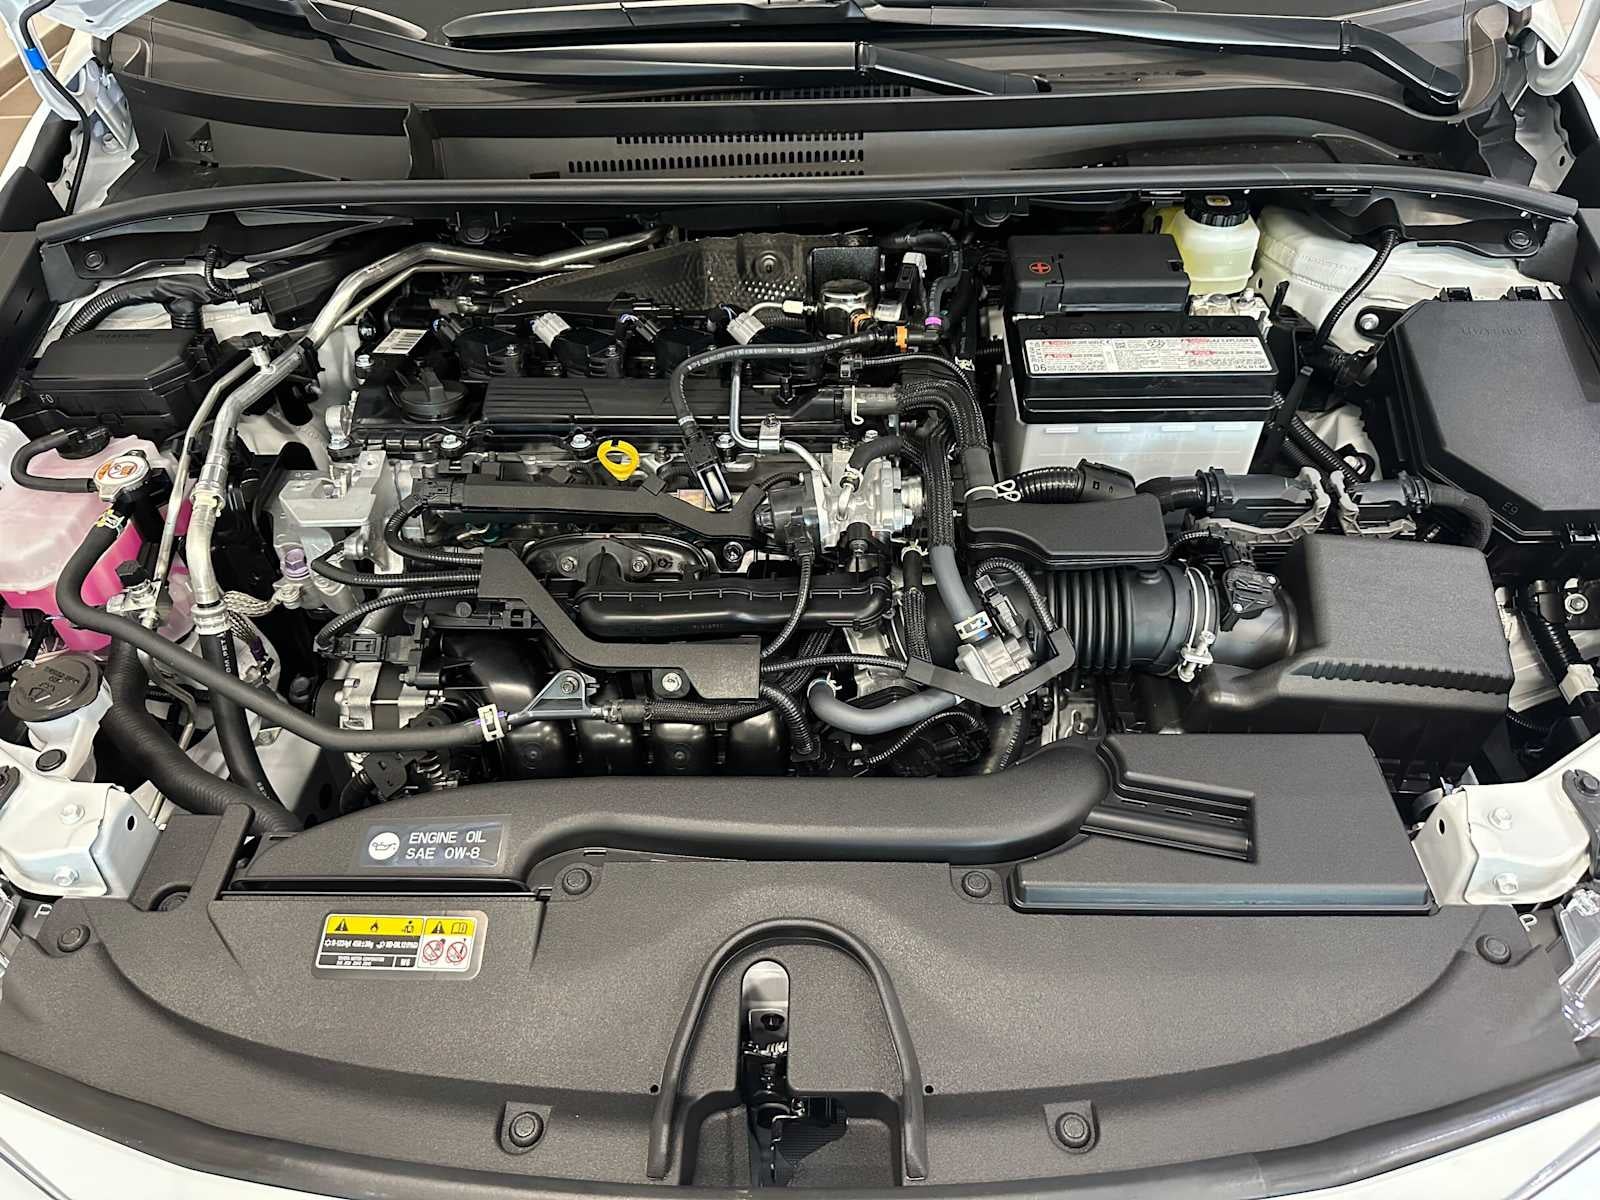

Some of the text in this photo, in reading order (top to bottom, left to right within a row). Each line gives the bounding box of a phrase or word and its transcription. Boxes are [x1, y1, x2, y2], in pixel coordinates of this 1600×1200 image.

[408, 830, 488, 844] ENGINE OIL
[405, 847, 437, 860] SAE
